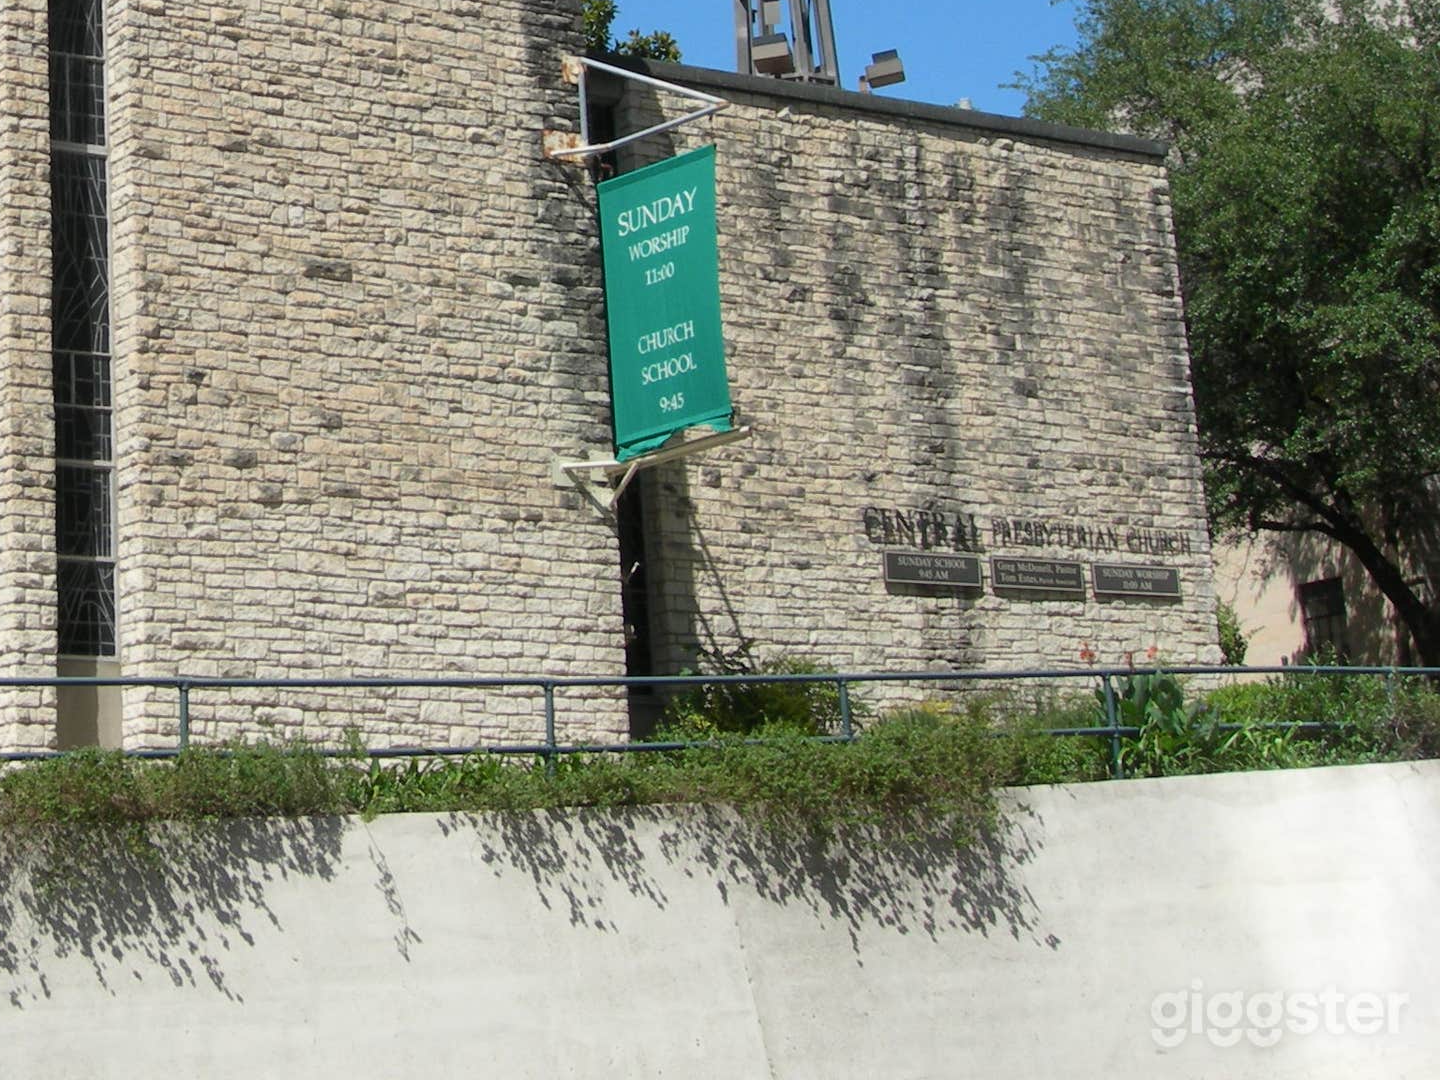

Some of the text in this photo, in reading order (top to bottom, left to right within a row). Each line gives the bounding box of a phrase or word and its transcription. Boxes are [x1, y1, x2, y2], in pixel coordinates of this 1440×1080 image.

[617, 186, 697, 237] SUNDAY
[628, 225, 690, 262] WORSHIP
[644, 261, 675, 286] 11:00
[637, 320, 695, 354] CHURCH
[640, 354, 697, 386] SCHOOL
[659, 392, 685, 413] 9:45
[862, 507, 1192, 554] CENTRAL PRESBYTERIAN CHURCH
[897, 556, 967, 569] SUNDAY SCHOOL
[935, 570, 949, 580] AM
[1102, 567, 1169, 580] SUNDAY WORSHIP
[1139, 580, 1153, 590] AM
